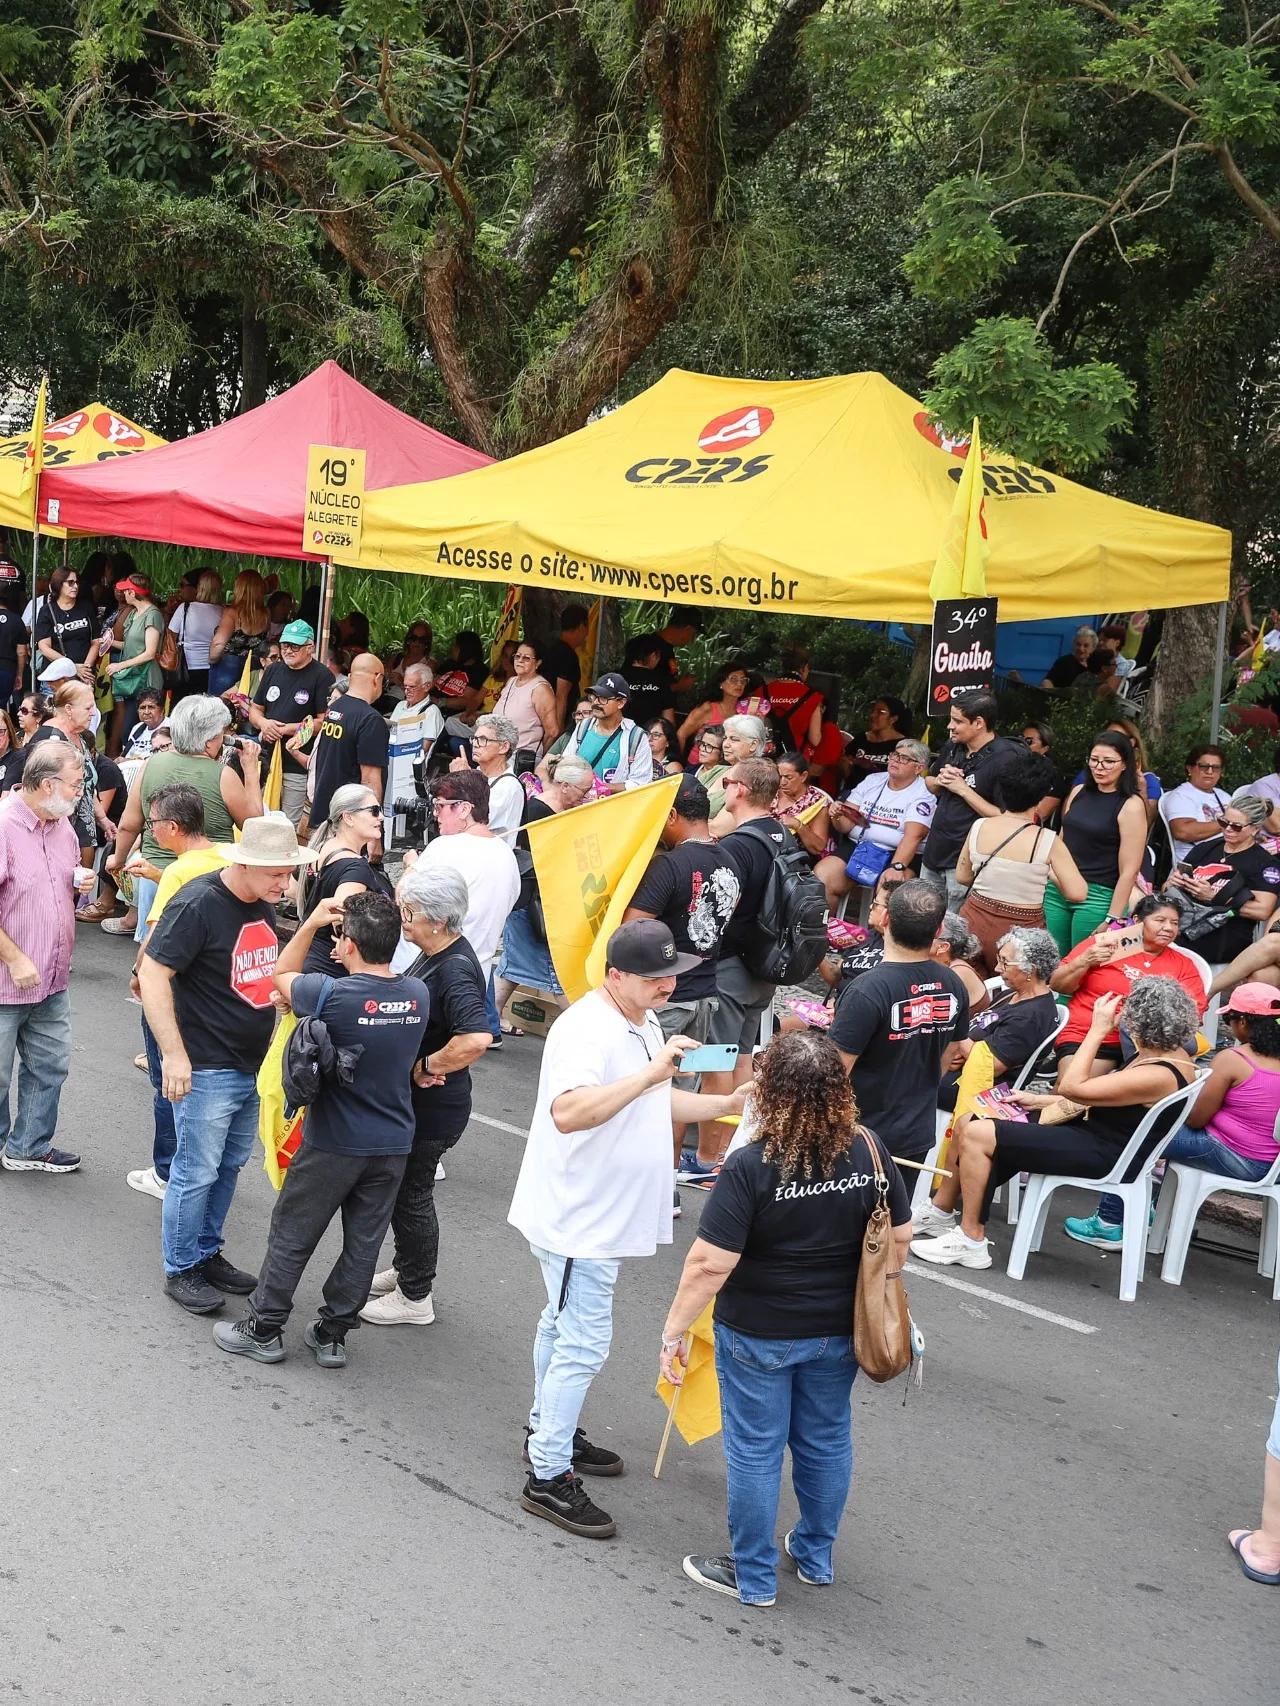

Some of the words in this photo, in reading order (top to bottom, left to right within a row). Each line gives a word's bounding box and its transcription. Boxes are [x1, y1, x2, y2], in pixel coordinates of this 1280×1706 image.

[625, 454, 774, 484] CPERS
[948, 465, 1056, 496] PERS
[310, 488, 360, 509] NÚCLEO
[307, 511, 358, 527] ALEGRETE
[324, 534, 352, 546] CPERS
[437, 541, 513, 571] Acesse
[521, 554, 533, 572] o
[236, 949, 253, 971] NÃO
[236, 973, 243, 984] A
[243, 967, 264, 983] MINHA
[378, 1001, 412, 1012] CPERS
[775, 1171, 873, 1202] Educação
